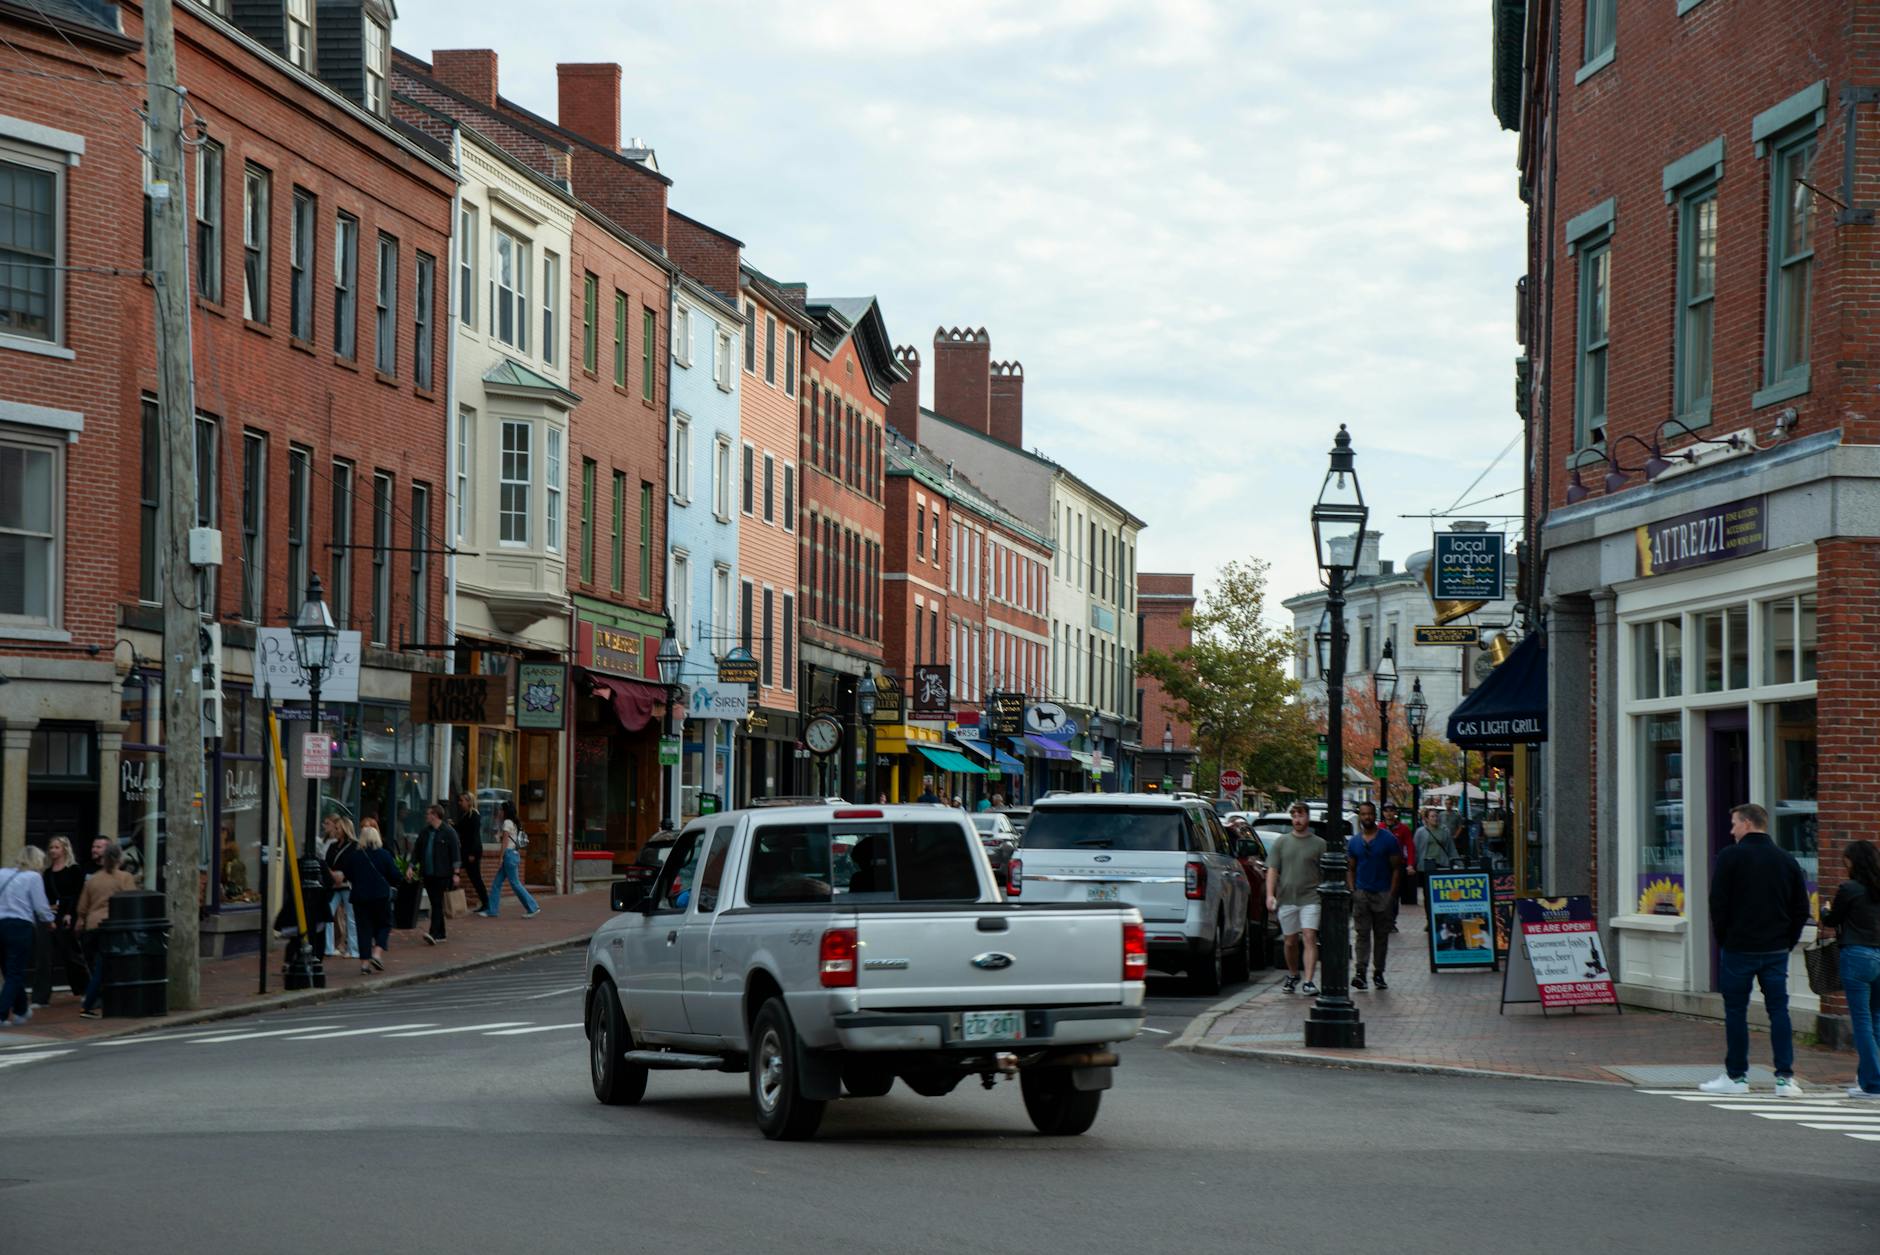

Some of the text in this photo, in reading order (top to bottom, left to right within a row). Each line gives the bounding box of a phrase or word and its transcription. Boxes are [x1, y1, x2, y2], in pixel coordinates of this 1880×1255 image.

[1451, 537, 1486, 551] local
[1653, 515, 1725, 565] ATTREZZI
[1442, 551, 1495, 564] anchor
[261, 636, 357, 665] Pree
[269, 665, 345, 675] BOUE
[522, 666, 563, 677] GANESH
[429, 677, 488, 698] FLOWER
[429, 695, 487, 721] KIOSK
[715, 697, 745, 707] SIREN
[962, 728, 979, 736] RSG
[1457, 719, 1541, 735] GAS LIGHT GRILL
[1221, 776, 1241, 785] STOP
[1432, 877, 1486, 890] HAPPY
[1440, 888, 1482, 901] HOUR
[1527, 924, 1542, 933] WE
[1542, 924, 1561, 932] ARE
[1555, 950, 1571, 961] beer
[1544, 982, 1608, 994] ORDER ONLINE
